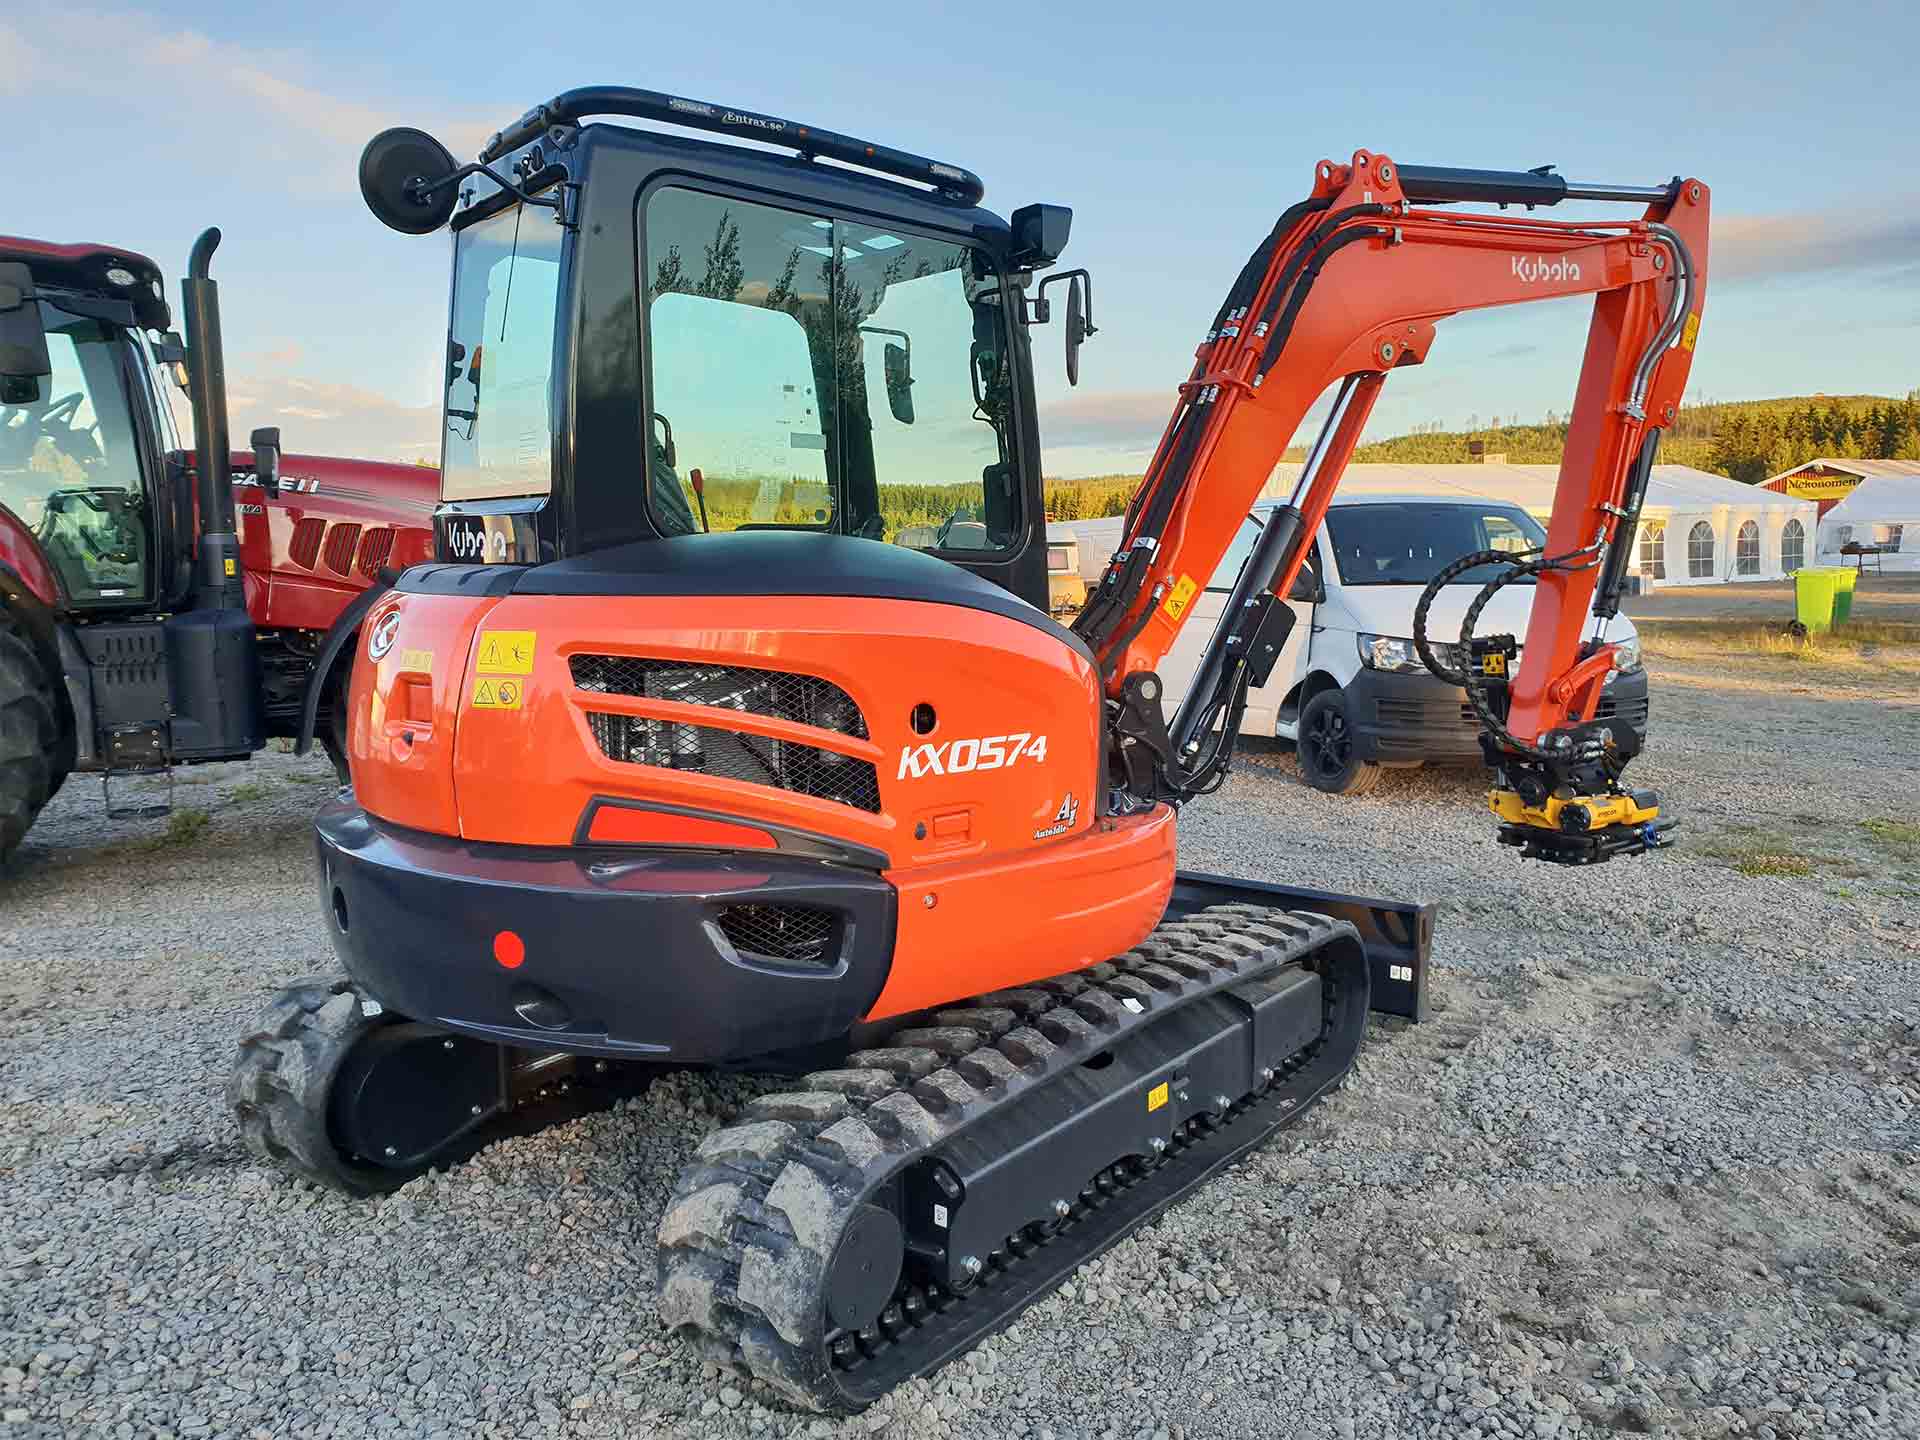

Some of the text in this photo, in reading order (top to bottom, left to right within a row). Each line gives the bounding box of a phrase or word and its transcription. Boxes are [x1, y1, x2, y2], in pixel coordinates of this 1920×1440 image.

[726, 111, 784, 131] Entrax.se
[1511, 256, 1580, 281] Kubota
[232, 473, 296, 490] CAE
[1788, 479, 1857, 489] Mekonomen
[448, 521, 507, 557] Kuboa
[897, 733, 1047, 780] KX057-4
